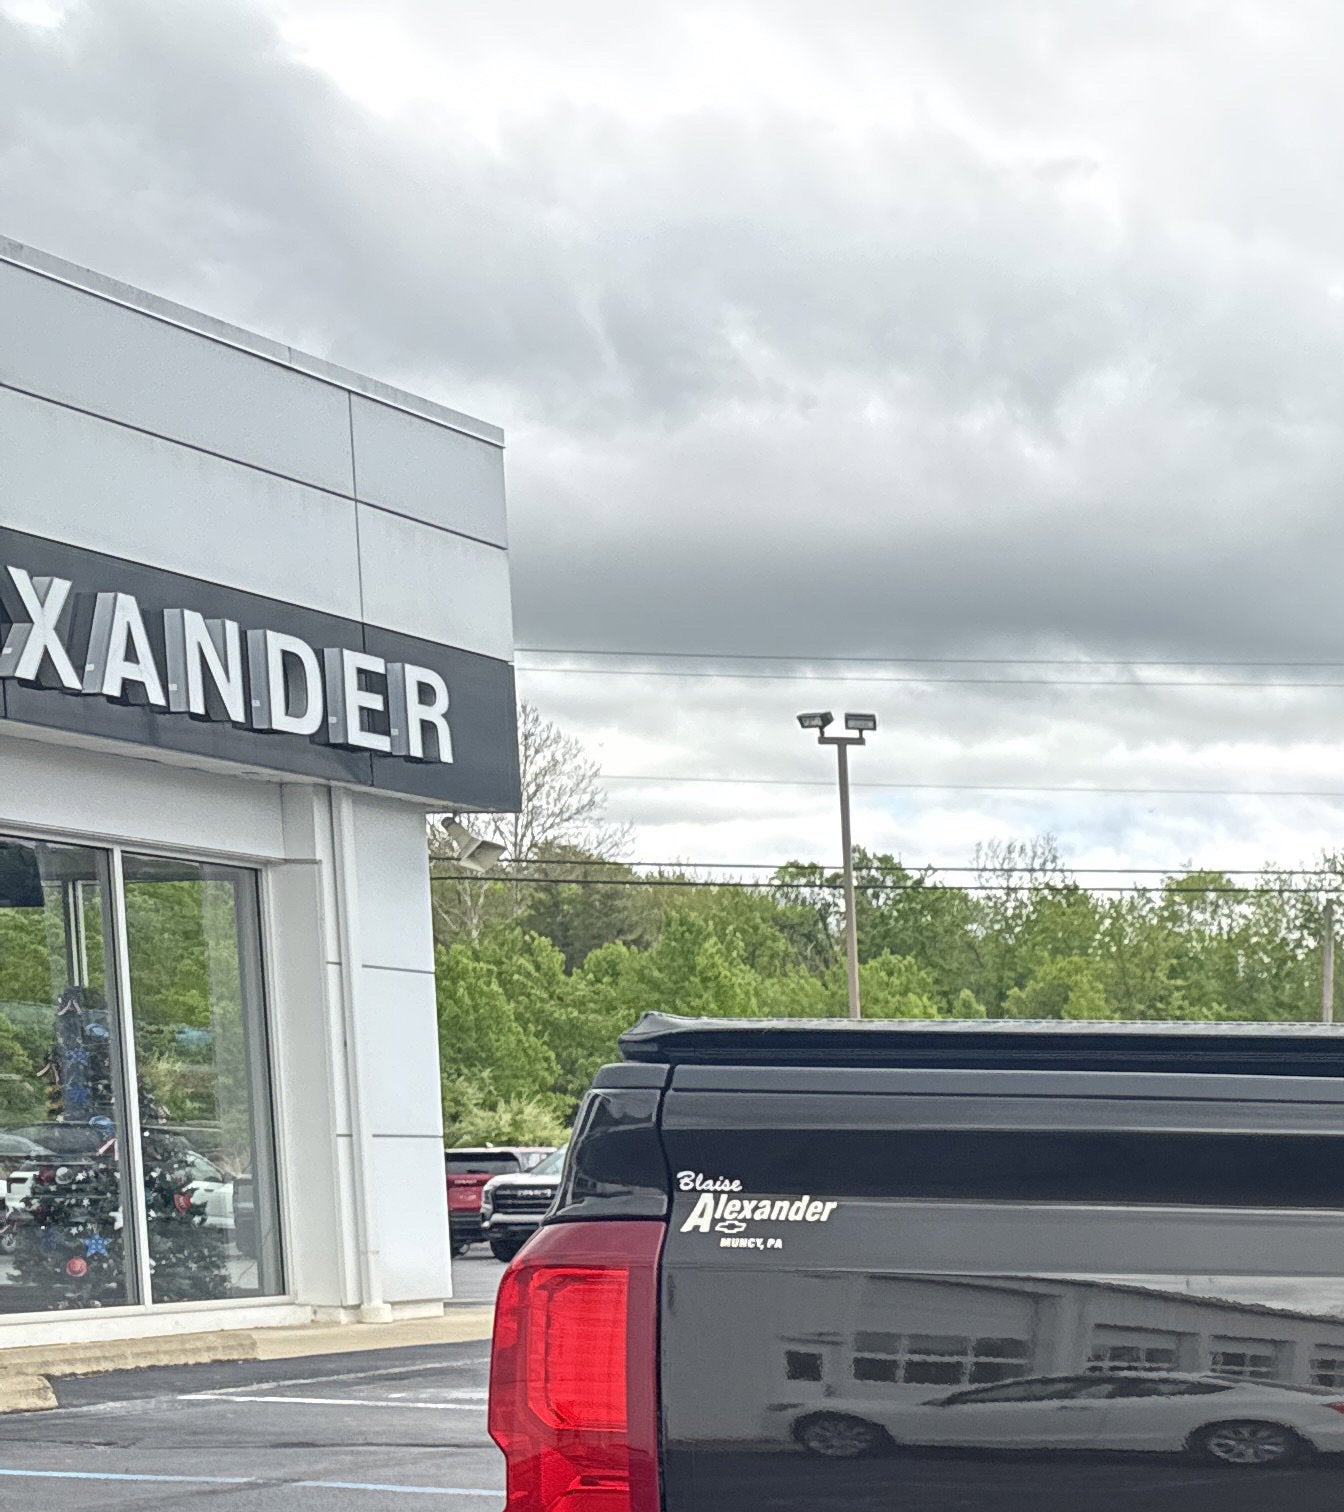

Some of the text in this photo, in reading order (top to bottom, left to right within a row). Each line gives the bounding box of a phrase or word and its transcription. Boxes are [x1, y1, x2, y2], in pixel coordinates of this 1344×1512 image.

[4, 565, 454, 763] XANDER
[676, 1170, 743, 1192] Blaise
[680, 1193, 838, 1233] Alexander
[767, 1238, 783, 1249] PA
